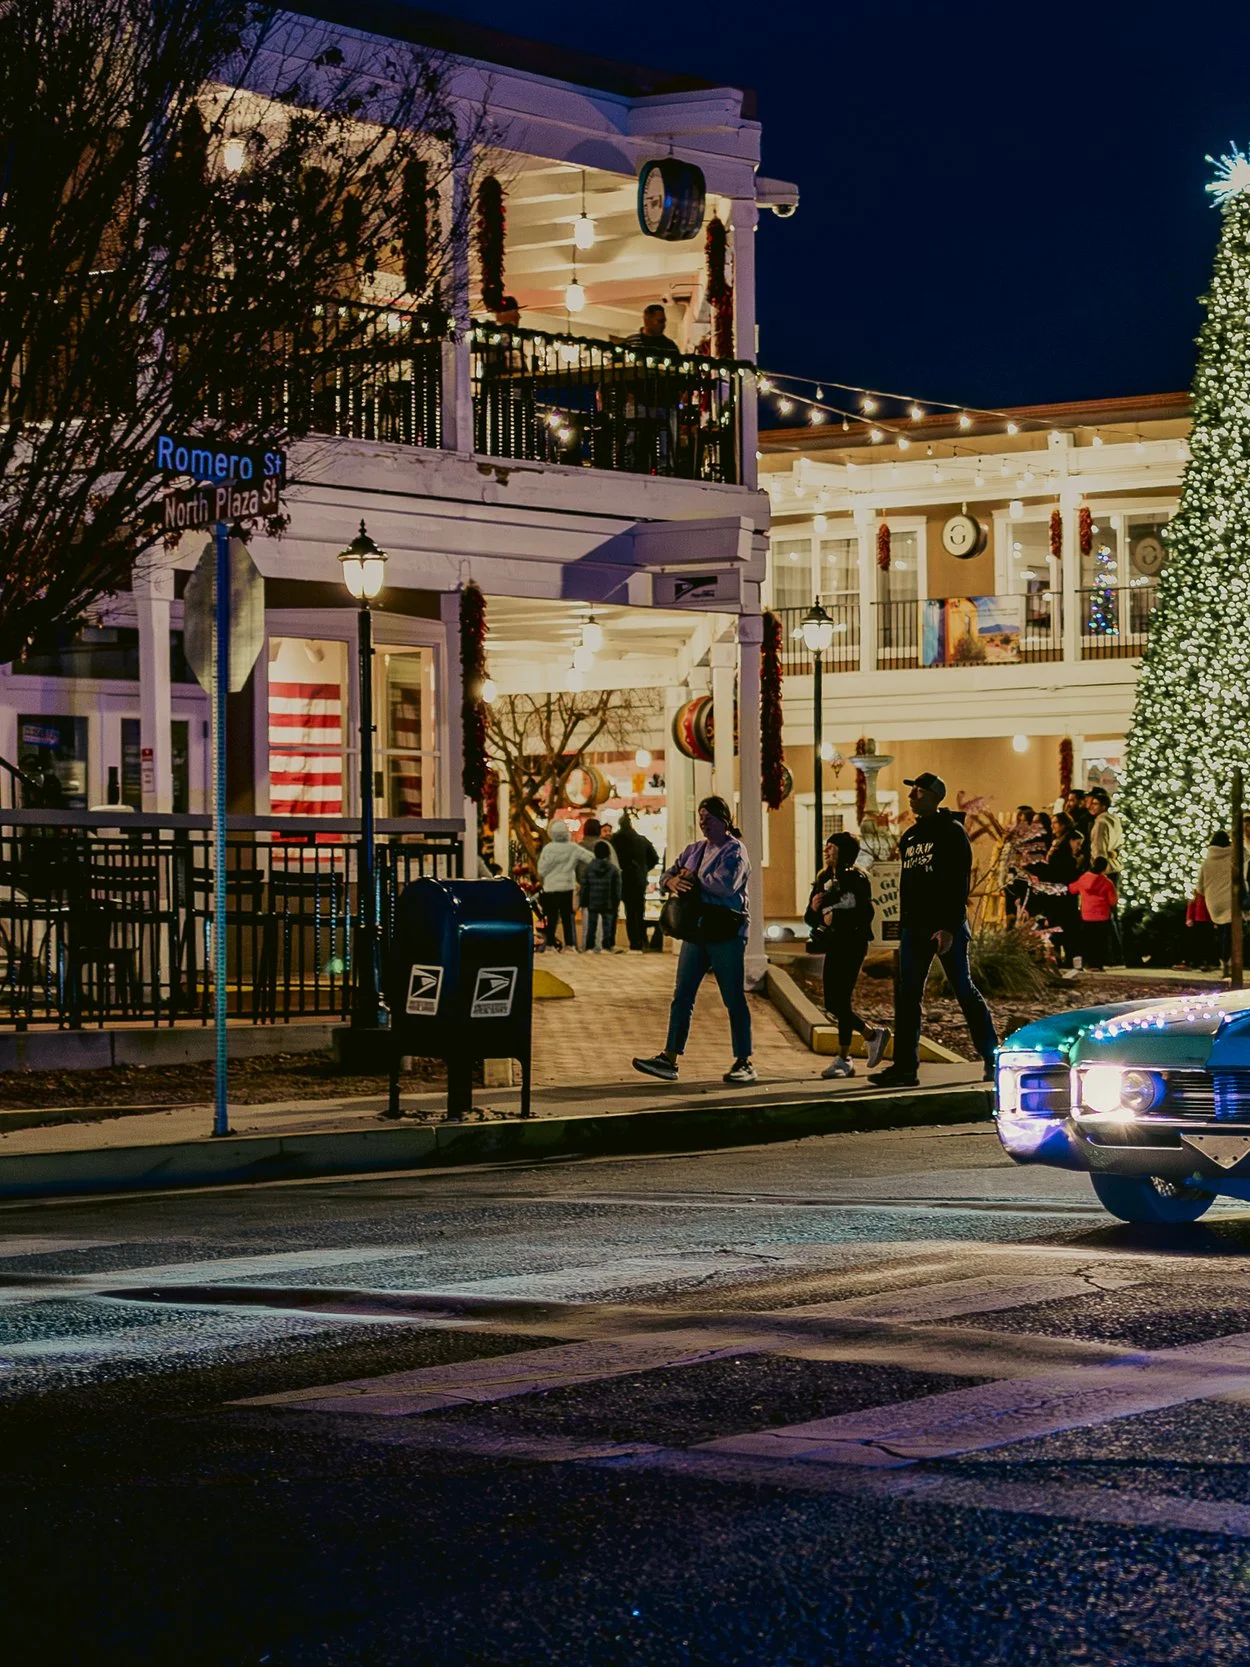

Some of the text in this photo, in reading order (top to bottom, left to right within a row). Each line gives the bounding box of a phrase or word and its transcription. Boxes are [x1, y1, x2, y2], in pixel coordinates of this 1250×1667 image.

[157, 436, 282, 479] Romero St
[165, 478, 277, 529] North Plaza St
